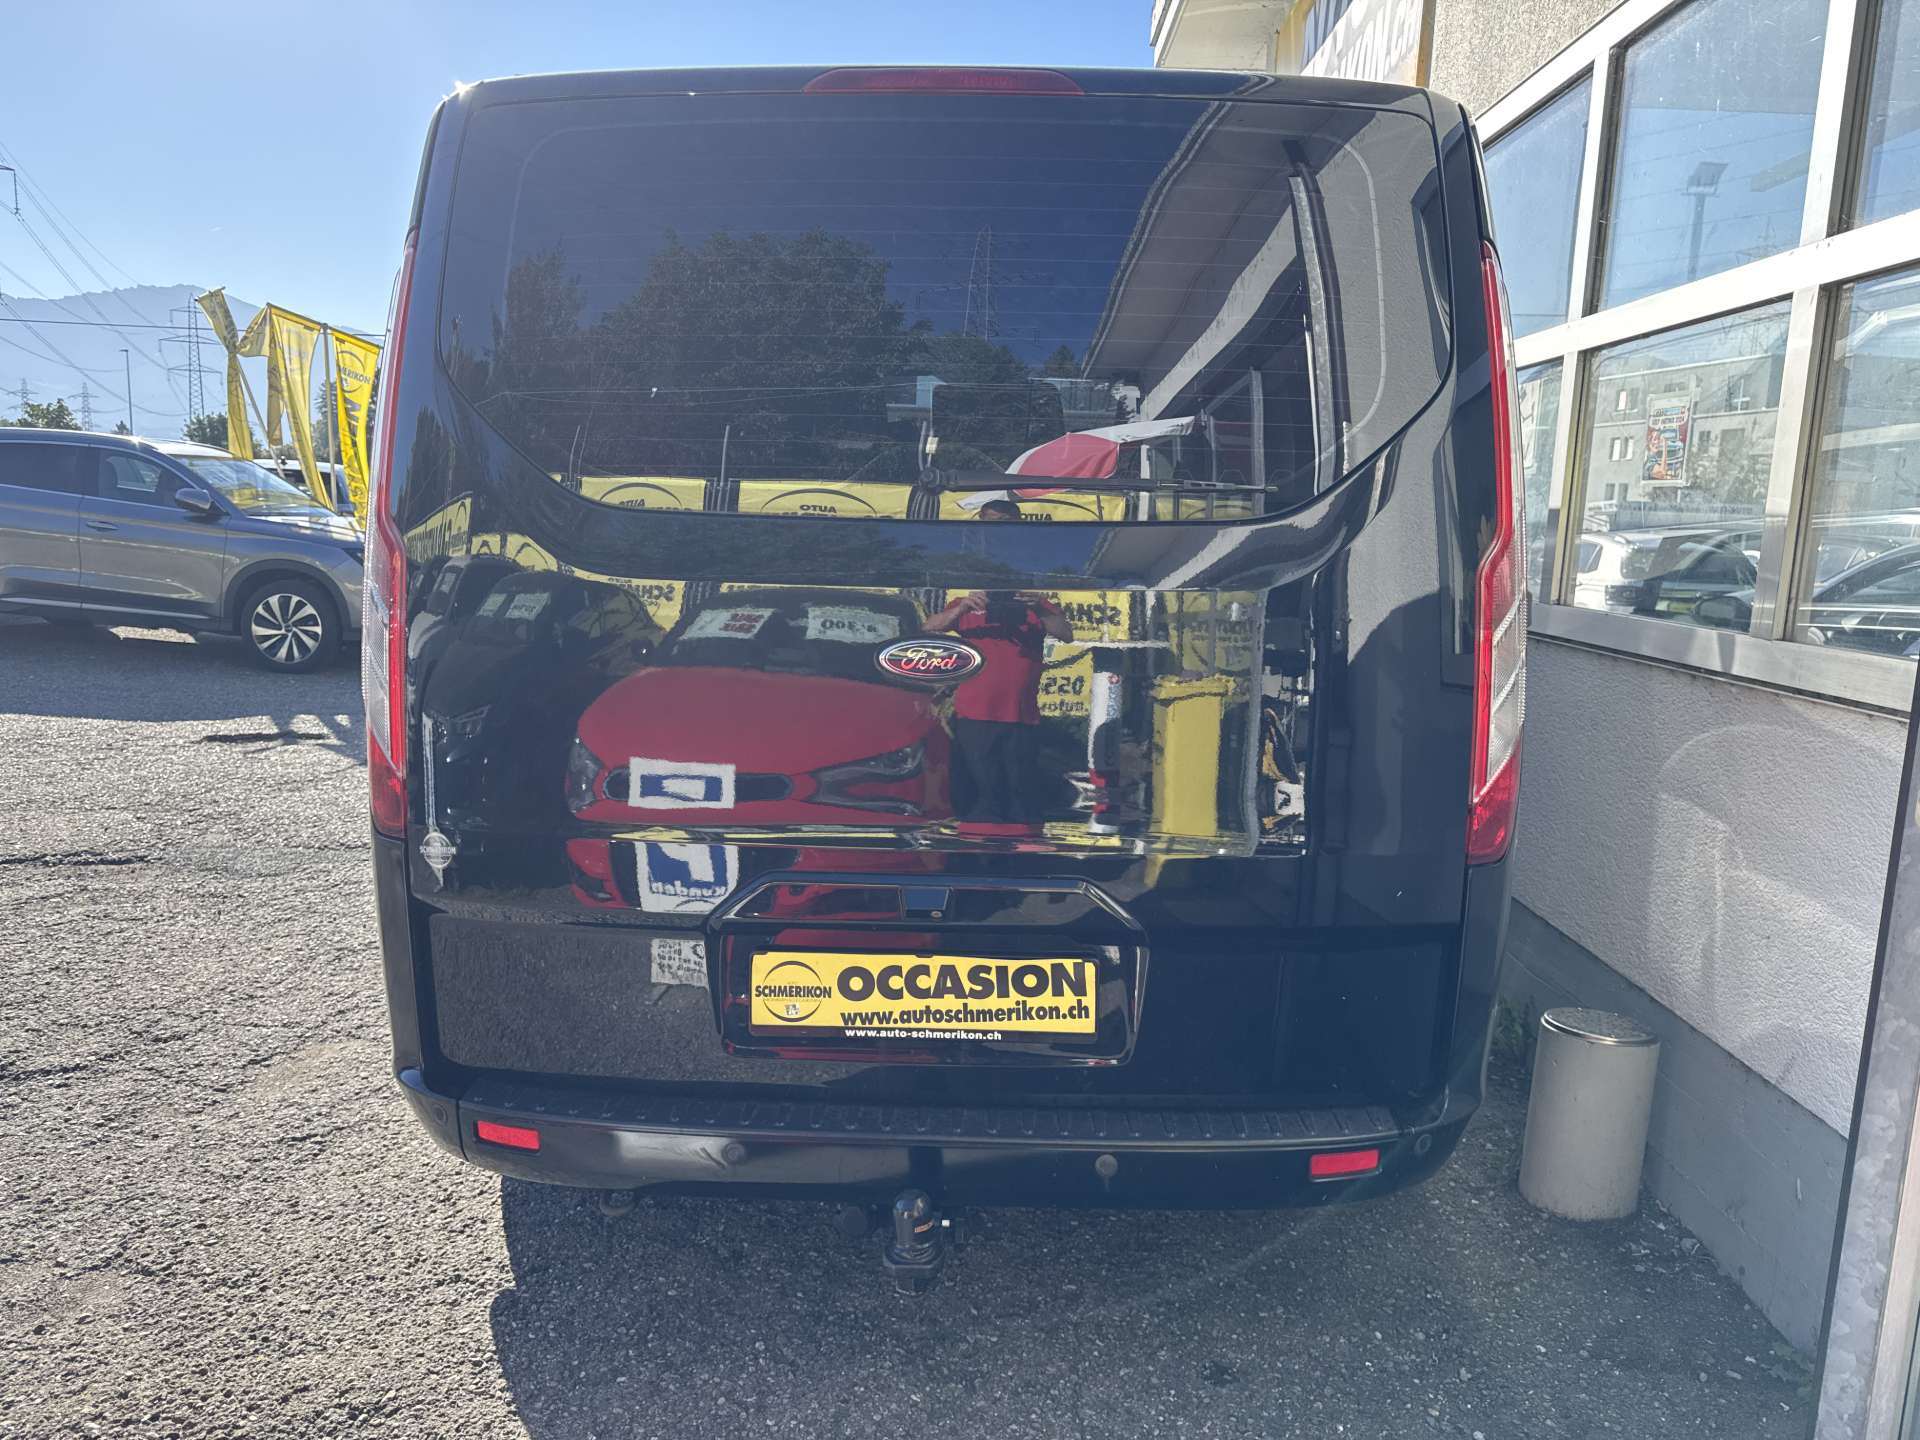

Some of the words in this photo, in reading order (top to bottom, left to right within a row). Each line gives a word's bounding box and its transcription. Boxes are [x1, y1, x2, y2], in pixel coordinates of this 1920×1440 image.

[901, 647, 957, 670] Ford
[755, 984, 832, 998] SCHMERIKON
[836, 962, 1088, 1001] OCCASION
[840, 999, 1090, 1026] www.autoschmerikon.ch
[845, 1028, 1002, 1041] www.auto-schmerikon.ch
